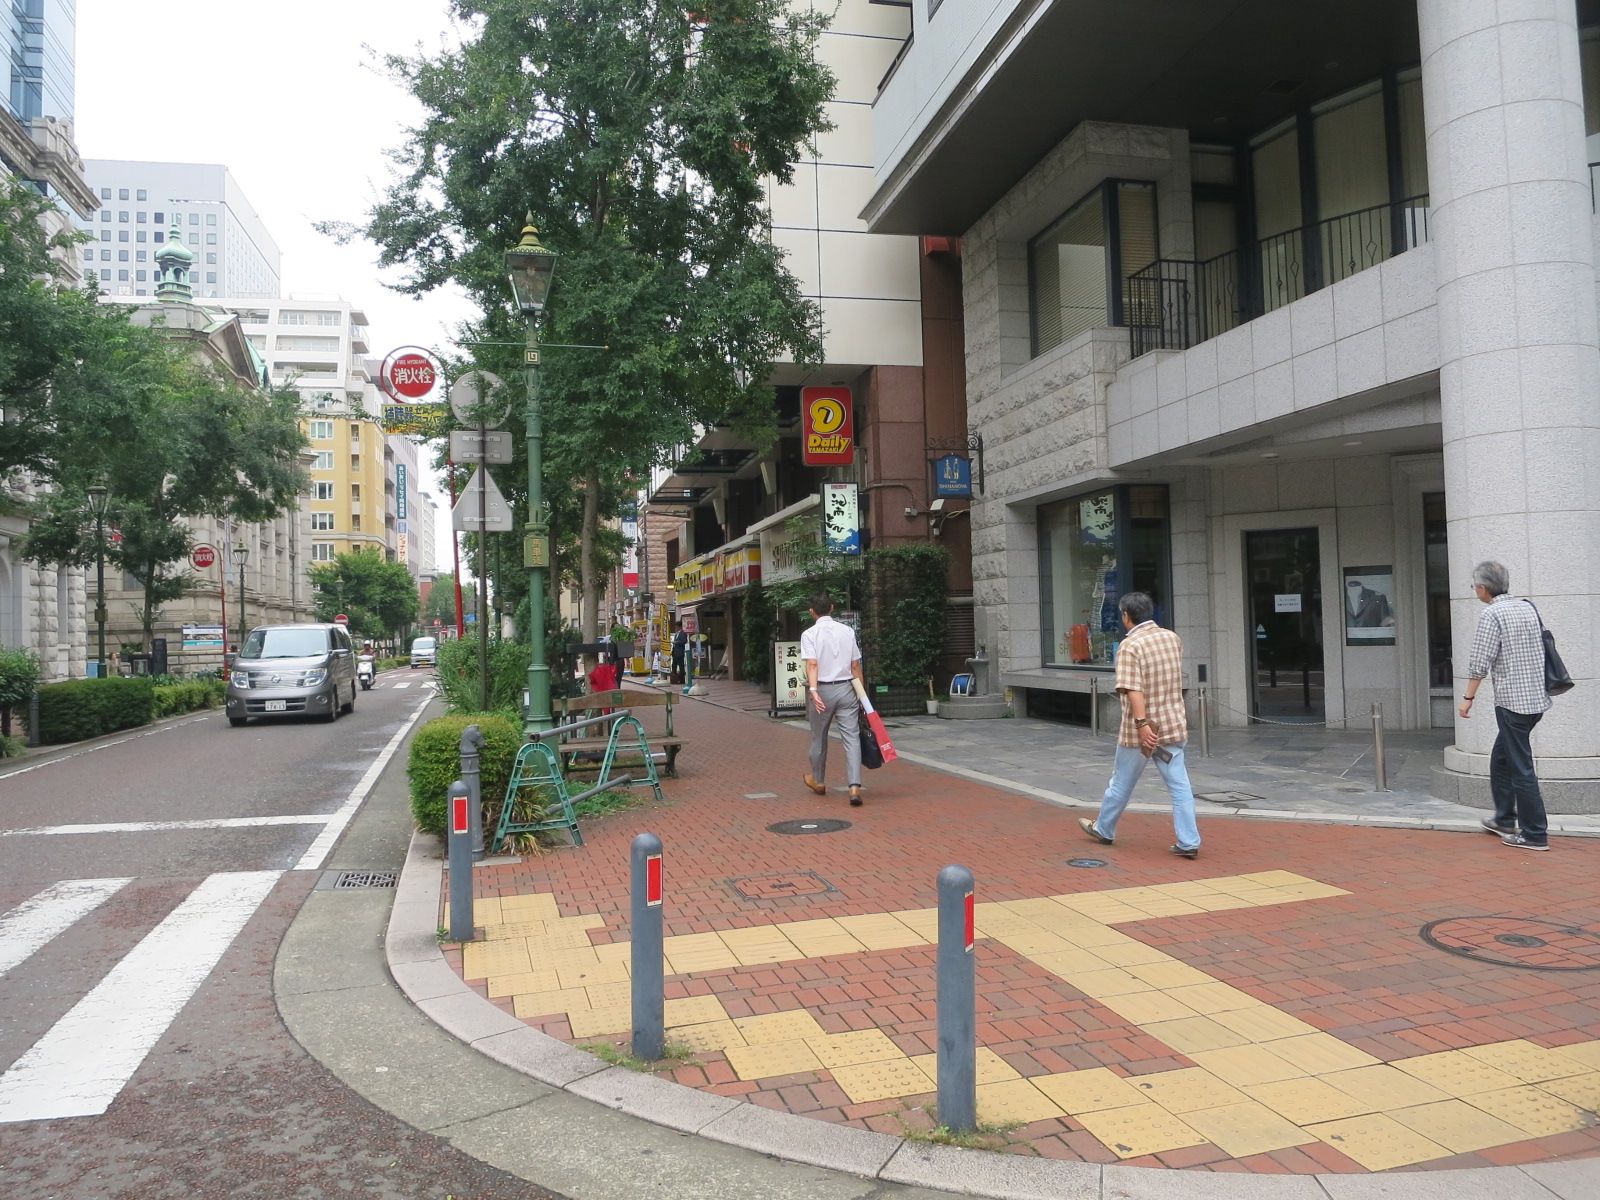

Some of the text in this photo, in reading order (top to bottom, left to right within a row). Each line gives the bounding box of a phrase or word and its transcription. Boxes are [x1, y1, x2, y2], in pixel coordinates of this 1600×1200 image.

[394, 367, 434, 384] 消火栓
[808, 434, 851, 454] Daily
